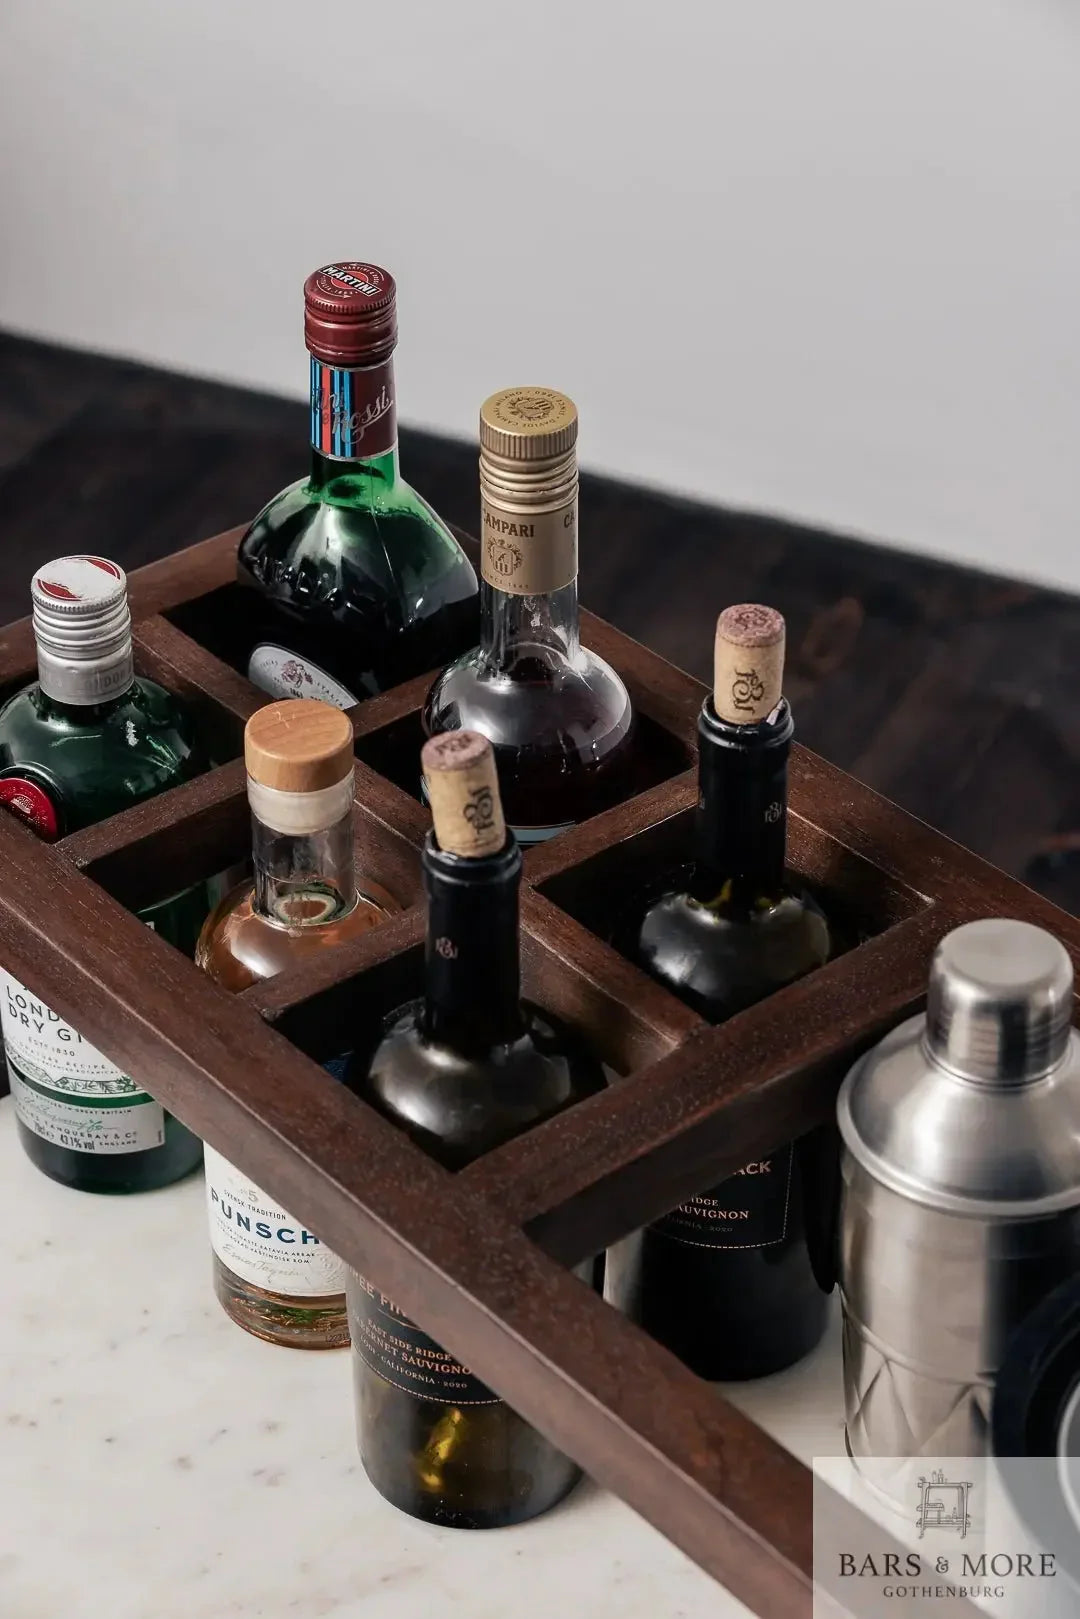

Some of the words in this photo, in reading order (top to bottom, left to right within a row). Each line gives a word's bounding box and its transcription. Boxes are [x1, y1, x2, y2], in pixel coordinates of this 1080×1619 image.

[322, 266, 378, 295] MARTINI
[6, 984, 60, 1022] LOND
[9, 1002, 45, 1034] DRY
[57, 1028, 82, 1043] GI
[52, 1047, 75, 1057] 1830
[66, 1061, 105, 1070] RECIPE
[44, 1119, 108, 1139] TANQUERAY
[84, 1140, 96, 1151] vol
[248, 1204, 286, 1220] TRADITION
[679, 1204, 750, 1220] AUVIGNON
[691, 1195, 719, 1207] IDGE
[210, 1185, 320, 1245] PUNSCH
[368, 1318, 388, 1338] EAST
[390, 1334, 413, 1351] SIDE
[415, 1346, 452, 1361] RIDGE
[381, 1355, 436, 1385] CALIFORNIA
[443, 1381, 468, 1389] 2020
[401, 1352, 473, 1376] SAUVIGNO
